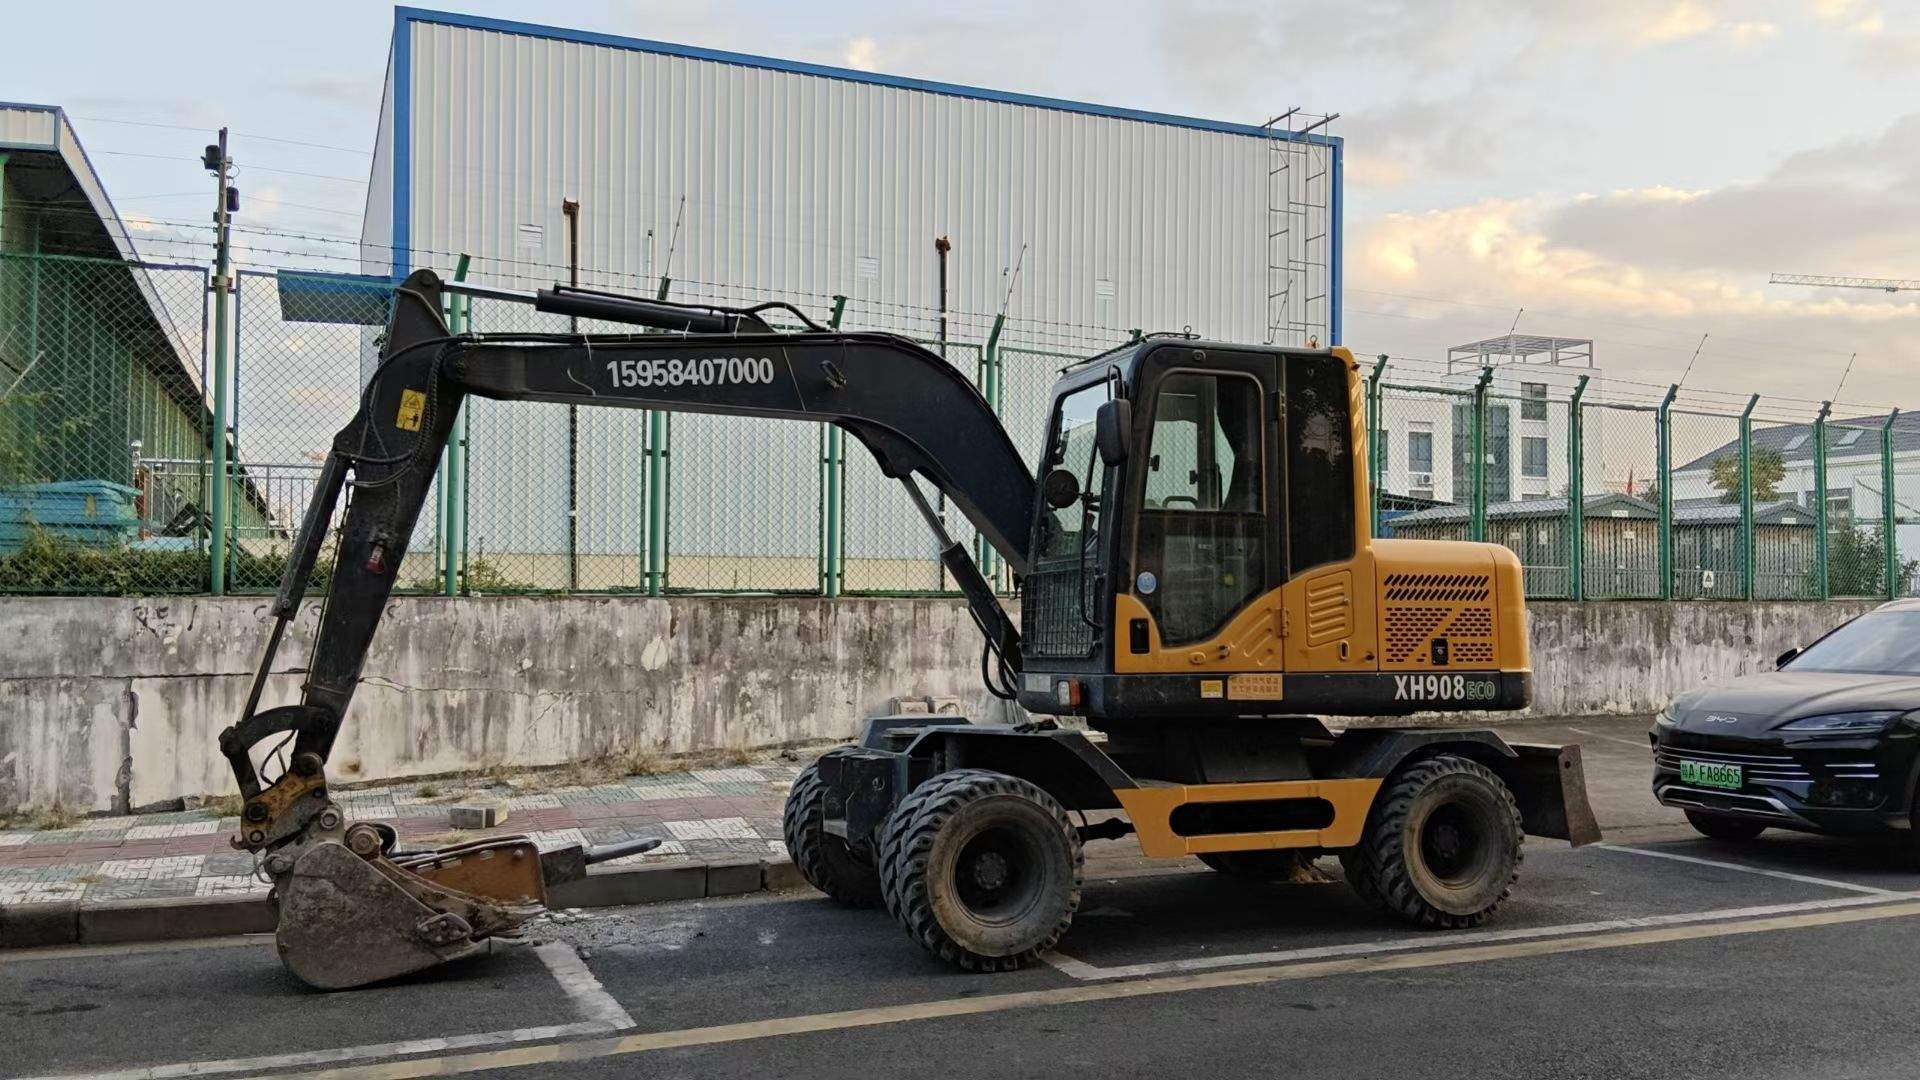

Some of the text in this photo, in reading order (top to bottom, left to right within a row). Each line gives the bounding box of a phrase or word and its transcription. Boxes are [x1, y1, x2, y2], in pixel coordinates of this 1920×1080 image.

[607, 357, 774, 388] 15958407000
[1394, 674, 1496, 700] XH908 ECO
